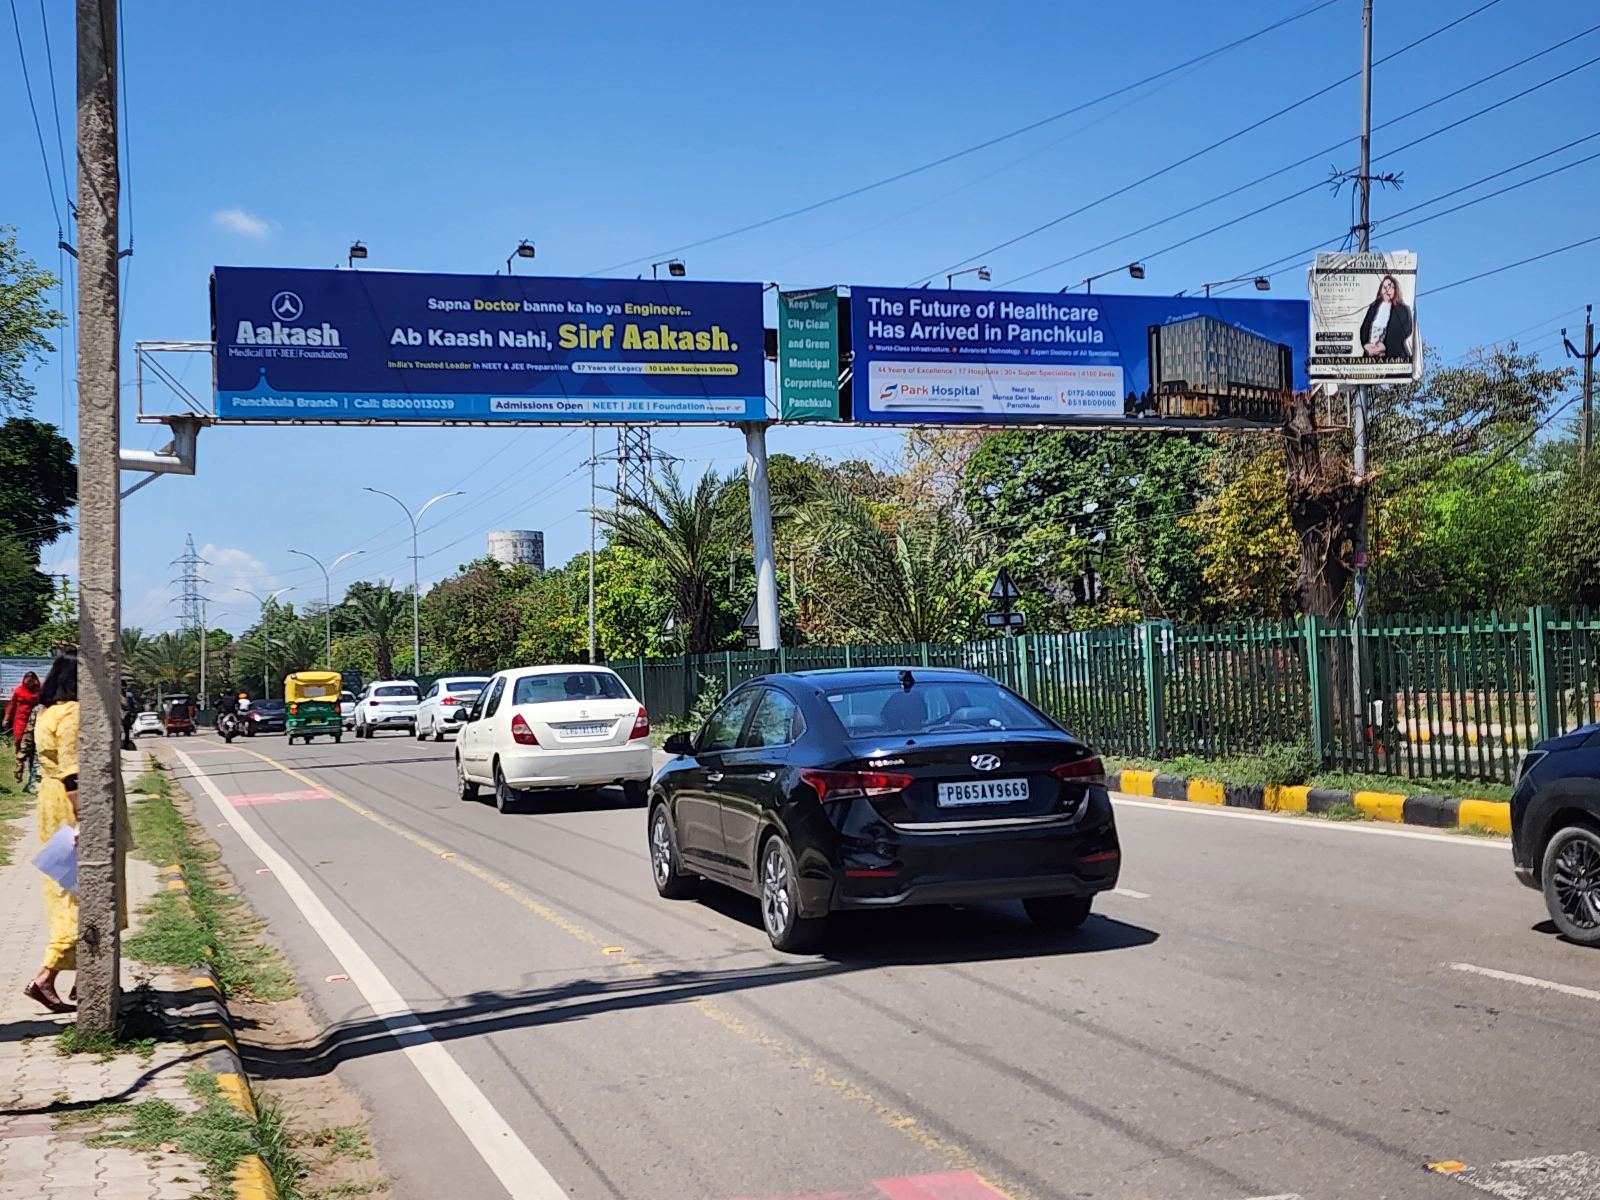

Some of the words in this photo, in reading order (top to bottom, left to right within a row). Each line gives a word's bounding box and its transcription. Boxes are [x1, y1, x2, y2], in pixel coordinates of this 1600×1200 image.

[428, 298, 471, 312] Sapna
[473, 299, 520, 311] Doctor
[523, 300, 564, 313] banne
[567, 301, 584, 313] ka
[586, 301, 604, 314] ho
[606, 304, 622, 316] ya
[624, 303, 691, 316] Engineer...
[788, 300, 809, 311] Keep
[810, 300, 828, 310] Your
[867, 297, 904, 316] The
[909, 299, 971, 318] Future
[975, 301, 996, 319] of
[1000, 302, 1099, 322] Healthcare
[788, 319, 804, 331] City
[805, 319, 830, 329] Clean
[236, 320, 340, 346] Aakash
[390, 328, 422, 345] Ab
[428, 329, 493, 347] Kaash
[499, 330, 553, 351] Nahi,
[558, 323, 615, 349] Sirf
[622, 324, 739, 351] Aakash.
[868, 321, 905, 339] Has
[910, 322, 979, 341] Arrived
[985, 323, 1002, 341] in
[1007, 324, 1104, 344] Panchkula
[788, 339, 804, 349] and
[805, 339, 830, 349] Green
[228, 348, 262, 357] Medical
[414, 361, 444, 369] Trusted
[526, 363, 569, 372] Preparation
[789, 358, 830, 371] Municipal
[784, 378, 835, 390] Corporation,
[901, 385, 930, 395] Park
[934, 385, 979, 398] Hospital
[232, 397, 295, 408] Panchkula
[296, 398, 339, 408] Branch
[353, 398, 380, 409] Call:
[496, 401, 554, 410] Admissions
[556, 402, 584, 411] Open
[592, 402, 618, 410] NEET
[626, 402, 645, 410] JEE
[652, 402, 706, 411] Foundation
[788, 397, 832, 408] Panchkula
